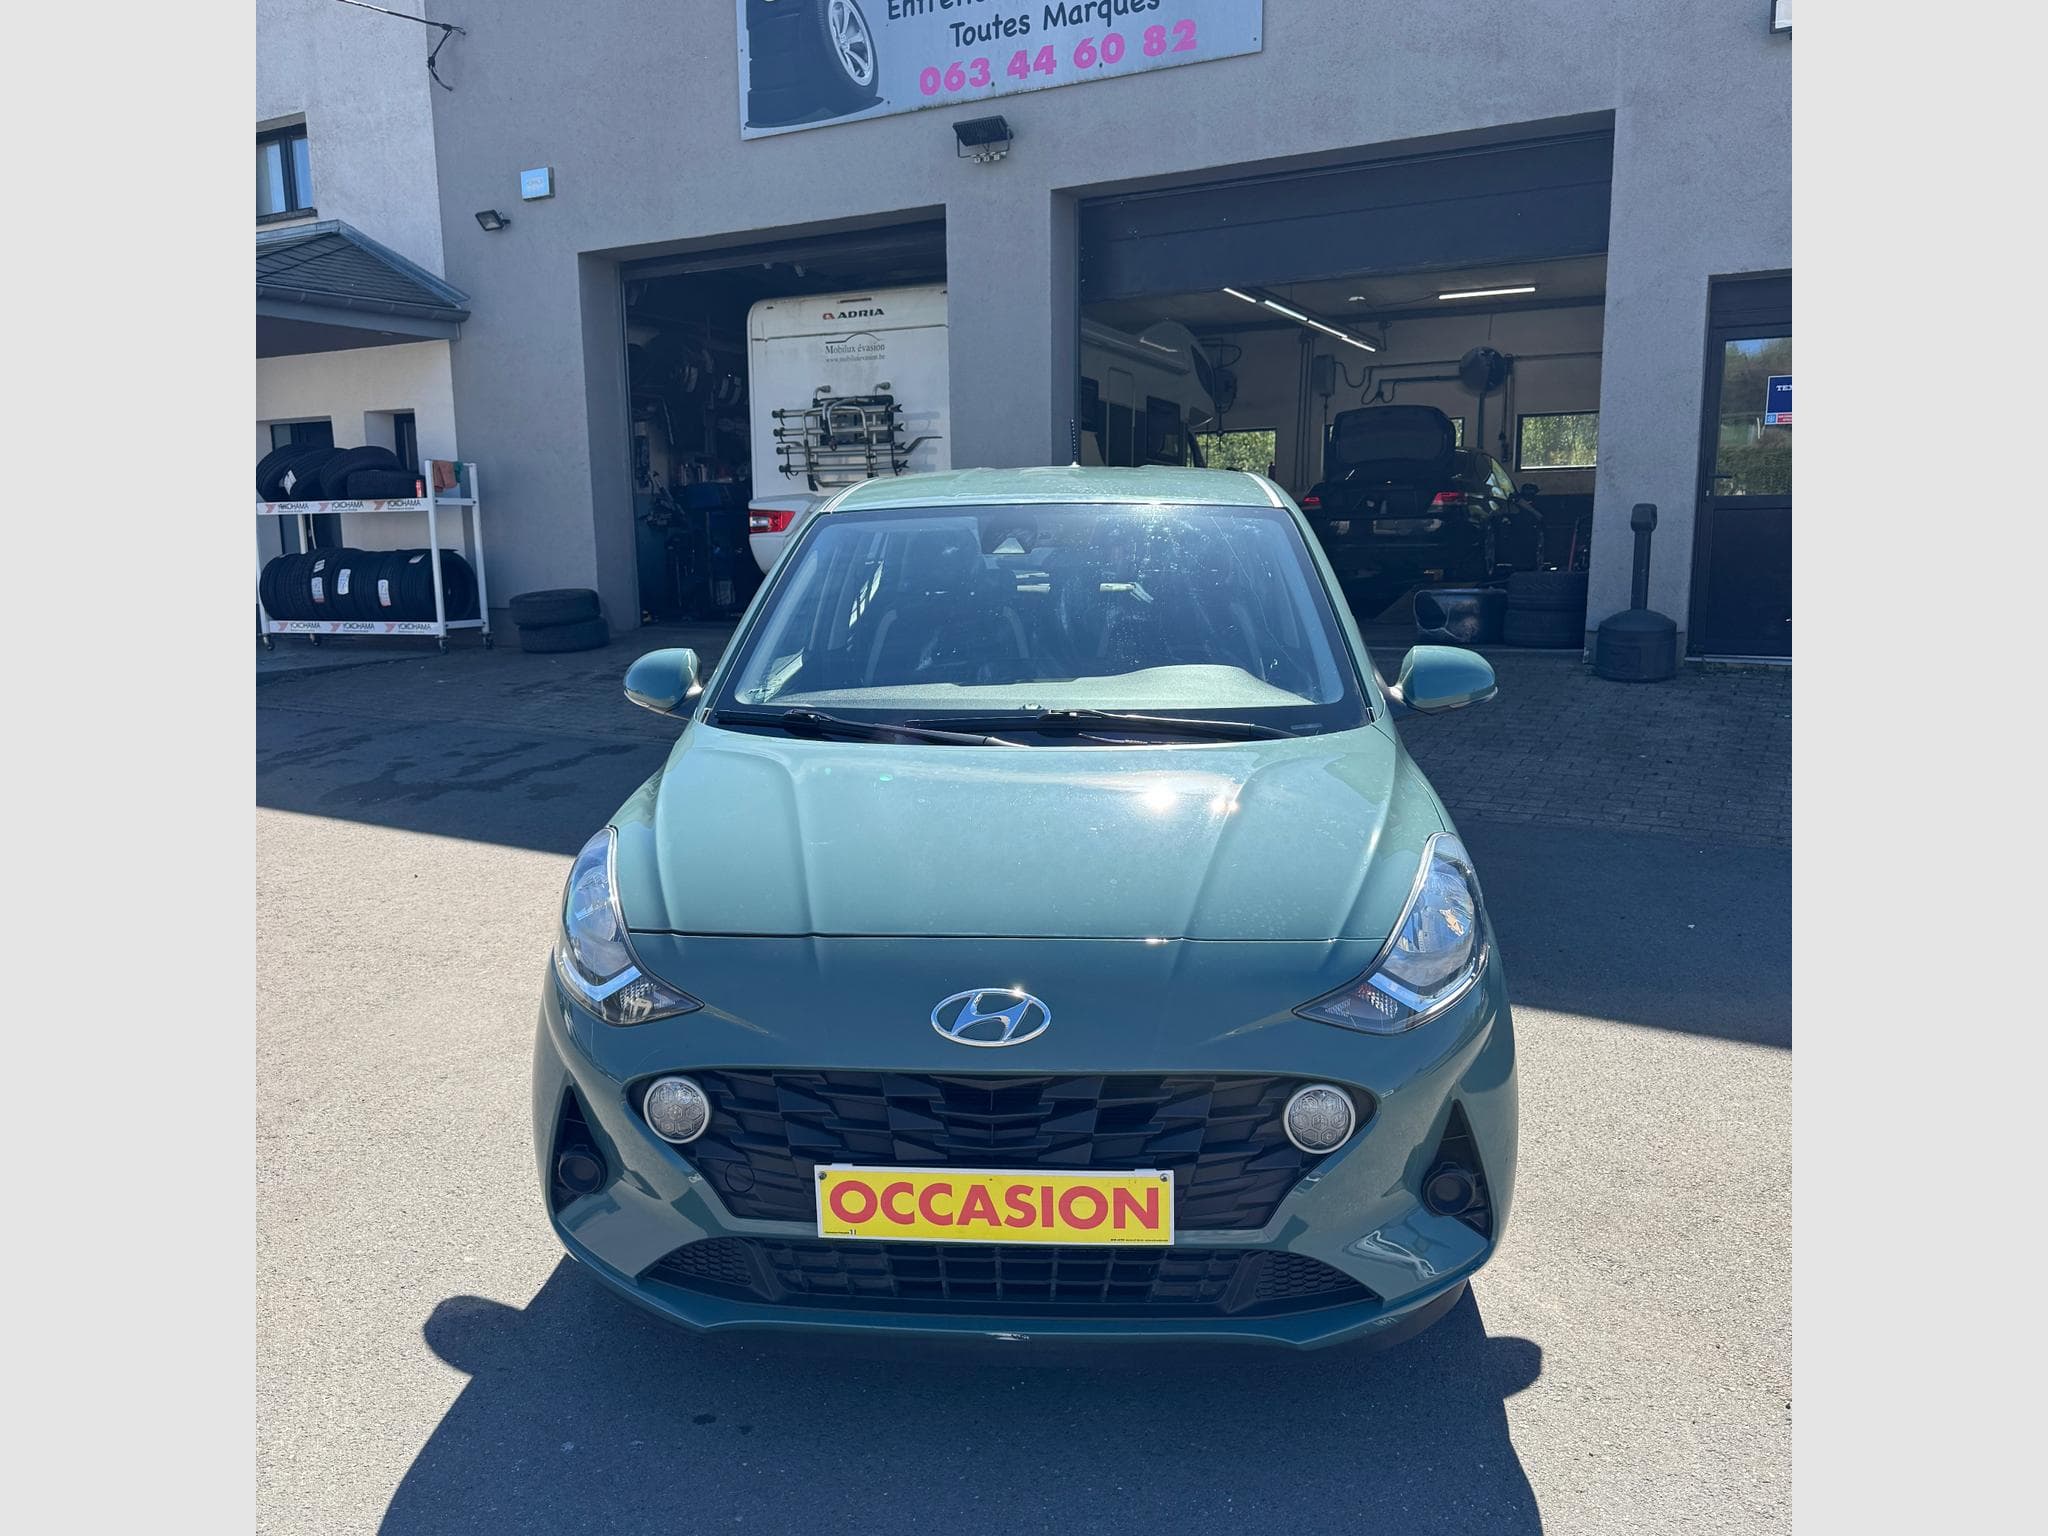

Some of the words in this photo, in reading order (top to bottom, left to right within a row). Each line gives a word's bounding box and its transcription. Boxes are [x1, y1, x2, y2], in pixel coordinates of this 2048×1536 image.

[949, 13, 1031, 48] Toutes
[1043, 0, 1161, 31] Marques
[919, 57, 991, 96] 063
[1007, 45, 1057, 80] 44
[1073, 32, 1126, 70] 60
[1143, 18, 1198, 57] 82
[837, 308, 885, 319] ADRIA
[825, 344, 856, 354] Mobilux
[857, 342, 886, 353] évasion
[332, 501, 364, 509] YOKOHAMA
[387, 499, 421, 507] YOKOHAMA
[343, 622, 375, 630] YOKOHAMA
[829, 1180, 1159, 1230] OCCASION
